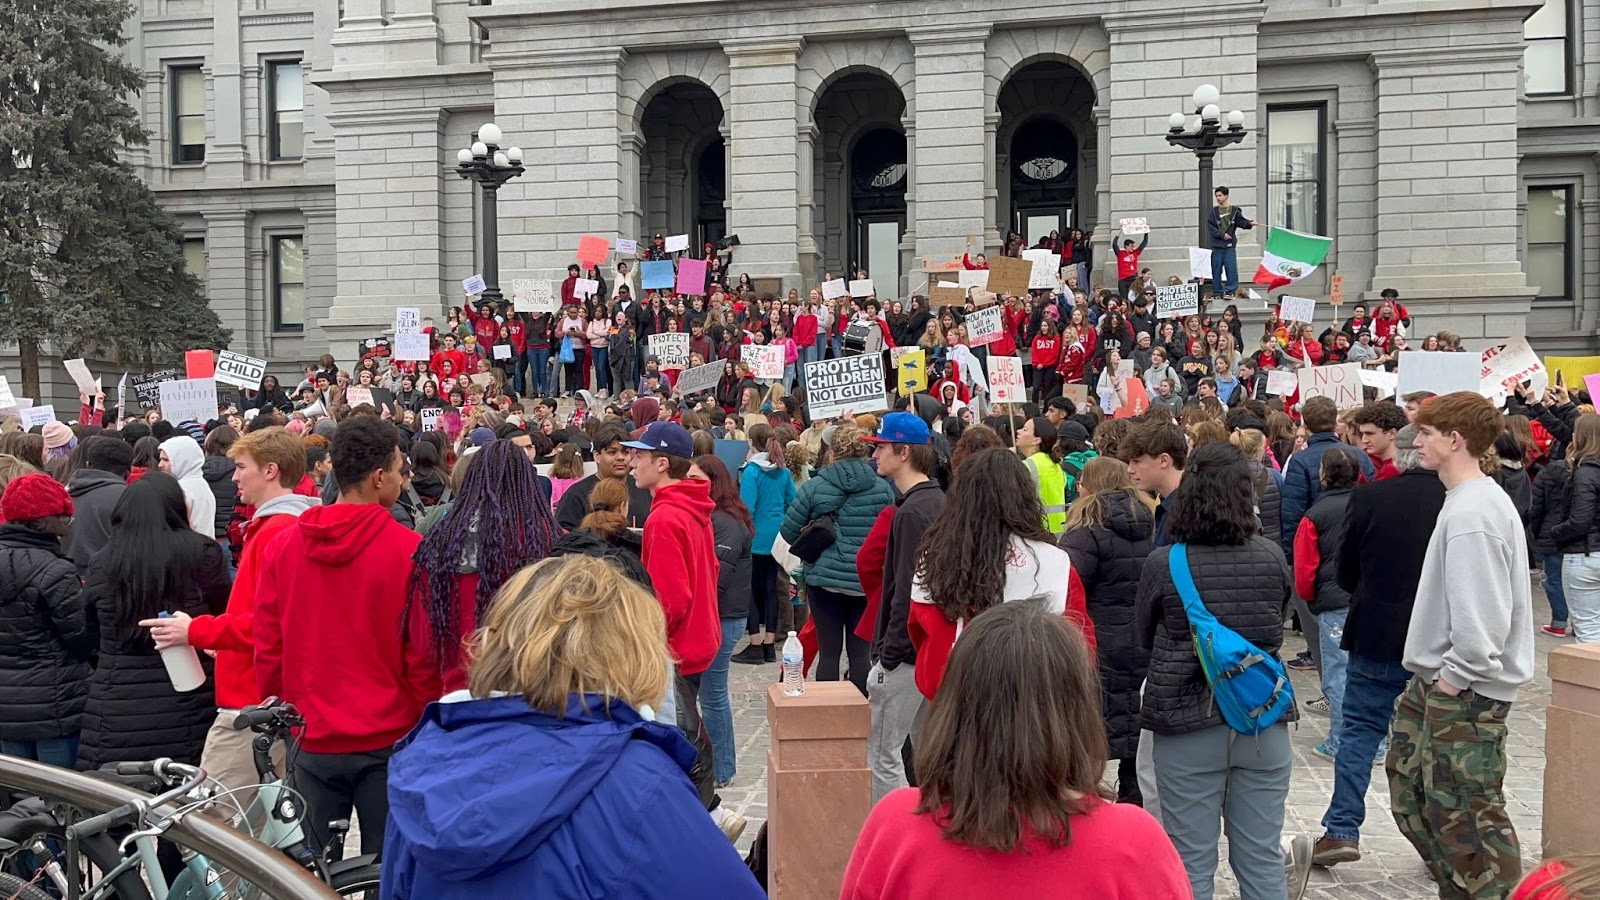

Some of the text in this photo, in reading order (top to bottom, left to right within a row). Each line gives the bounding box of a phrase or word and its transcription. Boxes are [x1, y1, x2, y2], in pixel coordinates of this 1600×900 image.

[1034, 255, 1060, 269] UIS
[514, 279, 550, 289] SIXTEEN
[1157, 284, 1197, 295] PROTECT
[525, 296, 549, 305] YOUNG
[1157, 292, 1197, 303] CHILDREN
[1158, 299, 1197, 309] NOT GUNS
[965, 307, 999, 324] HOW MANY
[652, 333, 689, 344] PROTECT
[1036, 339, 1056, 349] EAST
[652, 344, 683, 357] LIVES
[742, 349, 760, 360] ONE
[743, 345, 762, 353] NOT
[221, 351, 235, 361] NOT
[666, 355, 690, 365] GUNS
[218, 359, 262, 379] CHILD
[741, 357, 761, 369] MORE
[806, 354, 879, 378] PROTECT
[996, 358, 1014, 372] LUIS
[808, 368, 882, 390] CHILDREN
[989, 371, 1024, 388] GARCIA
[1313, 365, 1346, 386] NO
[810, 388, 839, 403] NOT
[841, 382, 883, 398] GUNS
[997, 387, 1013, 400] #11
